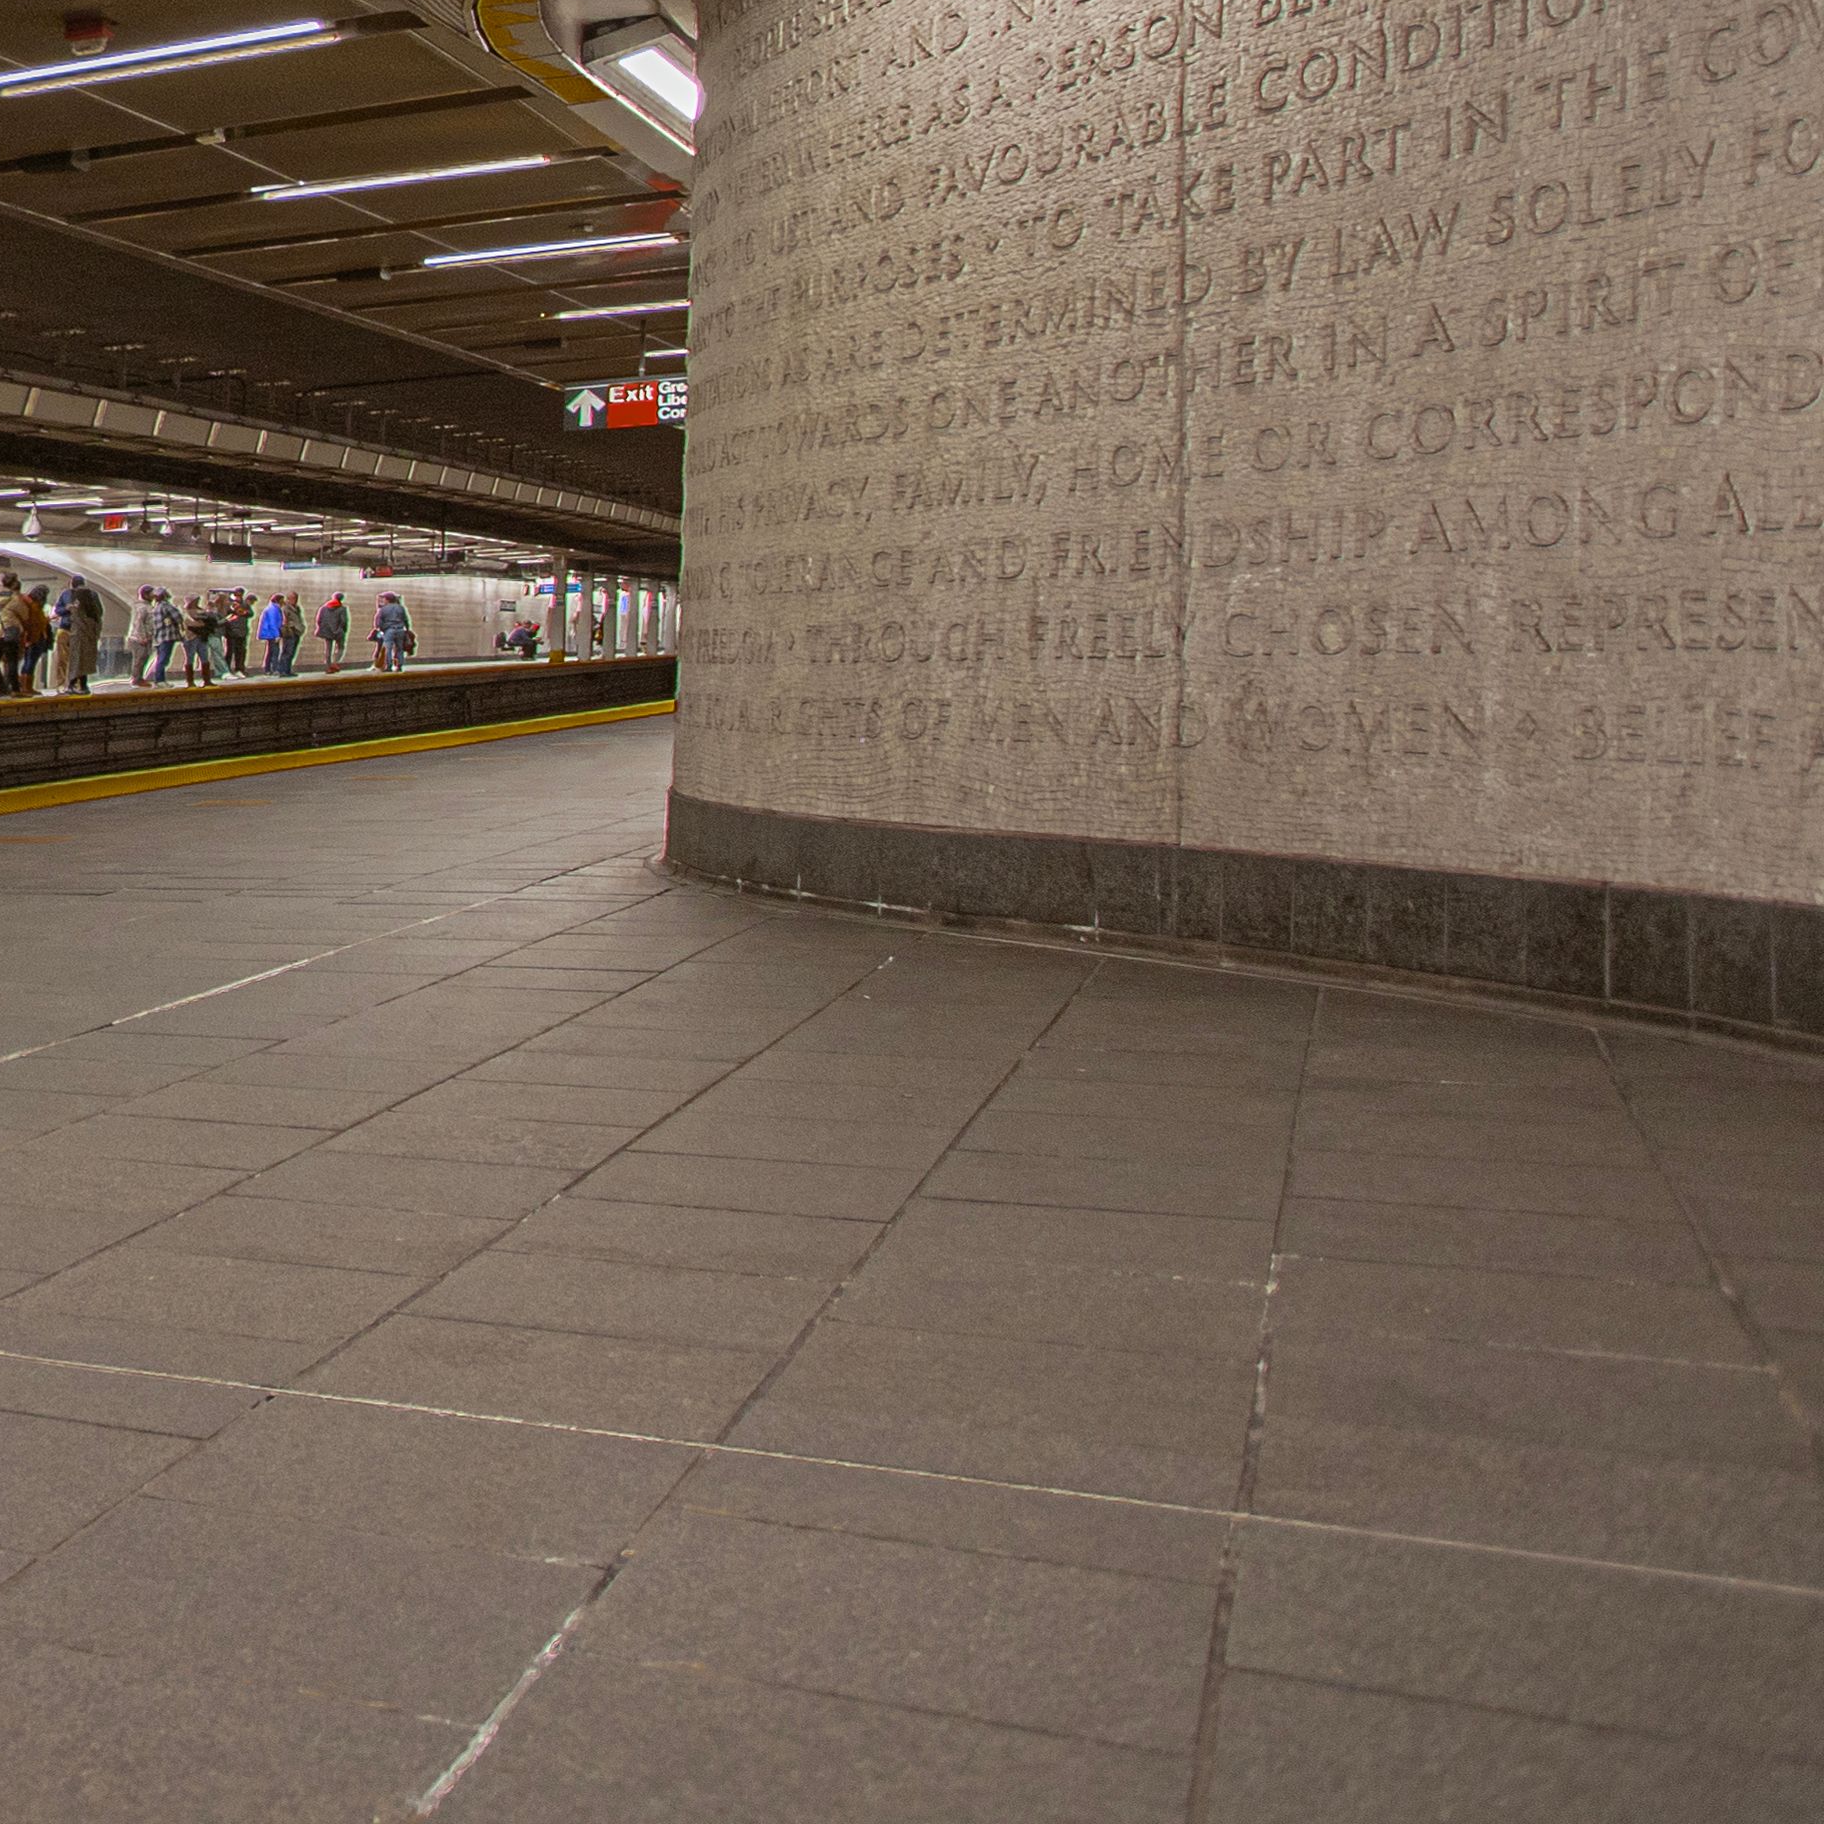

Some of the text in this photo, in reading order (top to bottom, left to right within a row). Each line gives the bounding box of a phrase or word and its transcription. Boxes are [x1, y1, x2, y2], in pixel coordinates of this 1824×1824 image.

[881, 13, 971, 76] AND
[922, 77, 1228, 210] FAVOURABLE
[1104, 163, 1238, 238] TAKE
[1261, 122, 1411, 205] PART
[1440, 88, 1509, 161] IN
[1535, 37, 1670, 129] THE
[903, 262, 1212, 361] DETERMINED
[1232, 237, 1304, 296] BY
[1329, 201, 1460, 278] LAW
[1486, 139, 1716, 246] SOLELY
[1745, 116, 1824, 186] FO
[924, 381, 1018, 430] ONE
[1033, 335, 1299, 416] ANOTHER
[1321, 320, 1389, 373] IN
[1407, 301, 1456, 357] A
[1479, 263, 1686, 348] SPIRIT
[1714, 237, 1795, 305] OF
[608, 384, 654, 403] Exit
[658, 381, 688, 394] Gre
[658, 394, 688, 406] Libe
[658, 407, 687, 420] Cor
[1067, 430, 1224, 493] HOME
[1251, 422, 1337, 473] OR
[1367, 348, 1824, 461] CORRESPOND
[928, 539, 1027, 585] AND
[1048, 509, 1386, 577] FRIENDSHIP
[1409, 485, 1679, 554] AMONG
[1701, 471, 1823, 537] ALL
[805, 621, 1004, 664] THROUGH
[1222, 598, 1475, 657] CHOSEN
[1510, 583, 1824, 654] REPRESEN
[1090, 696, 1206, 750] AND
